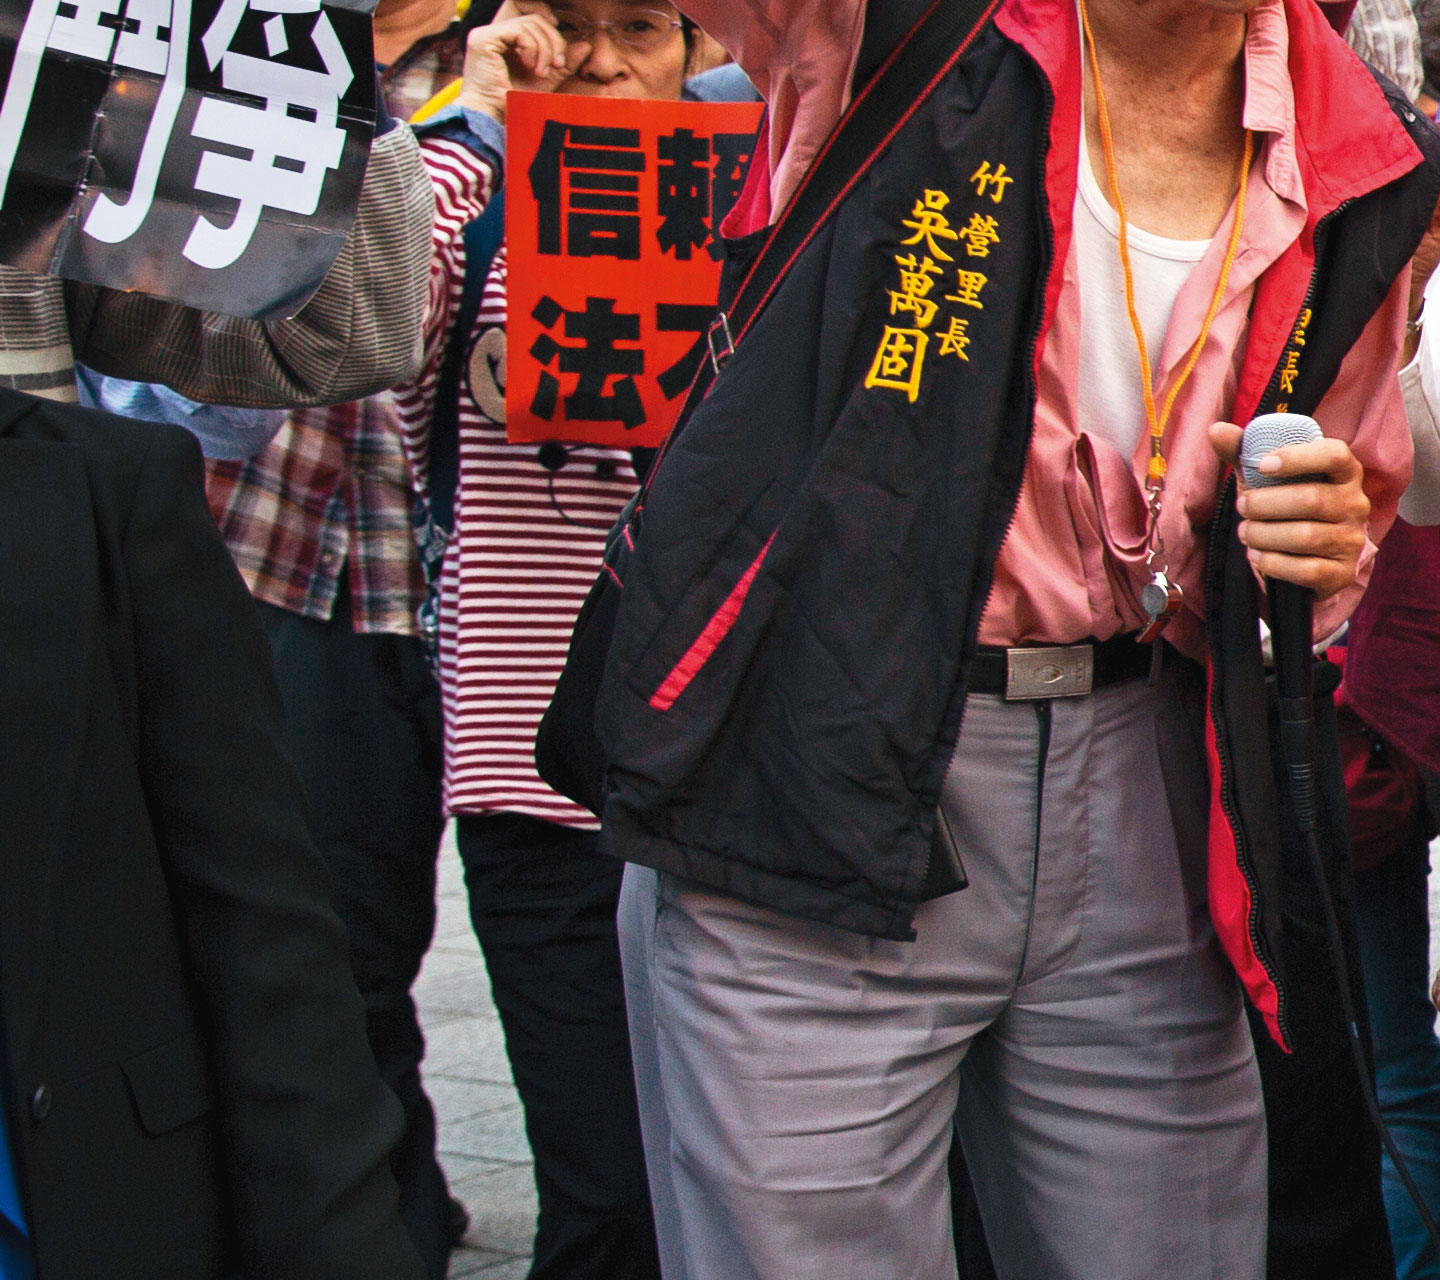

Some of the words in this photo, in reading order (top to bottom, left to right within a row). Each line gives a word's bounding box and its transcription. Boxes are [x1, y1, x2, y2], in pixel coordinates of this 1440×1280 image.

[863, 187, 957, 404] 吳萬固
[936, 160, 1014, 363] 竹營里長
